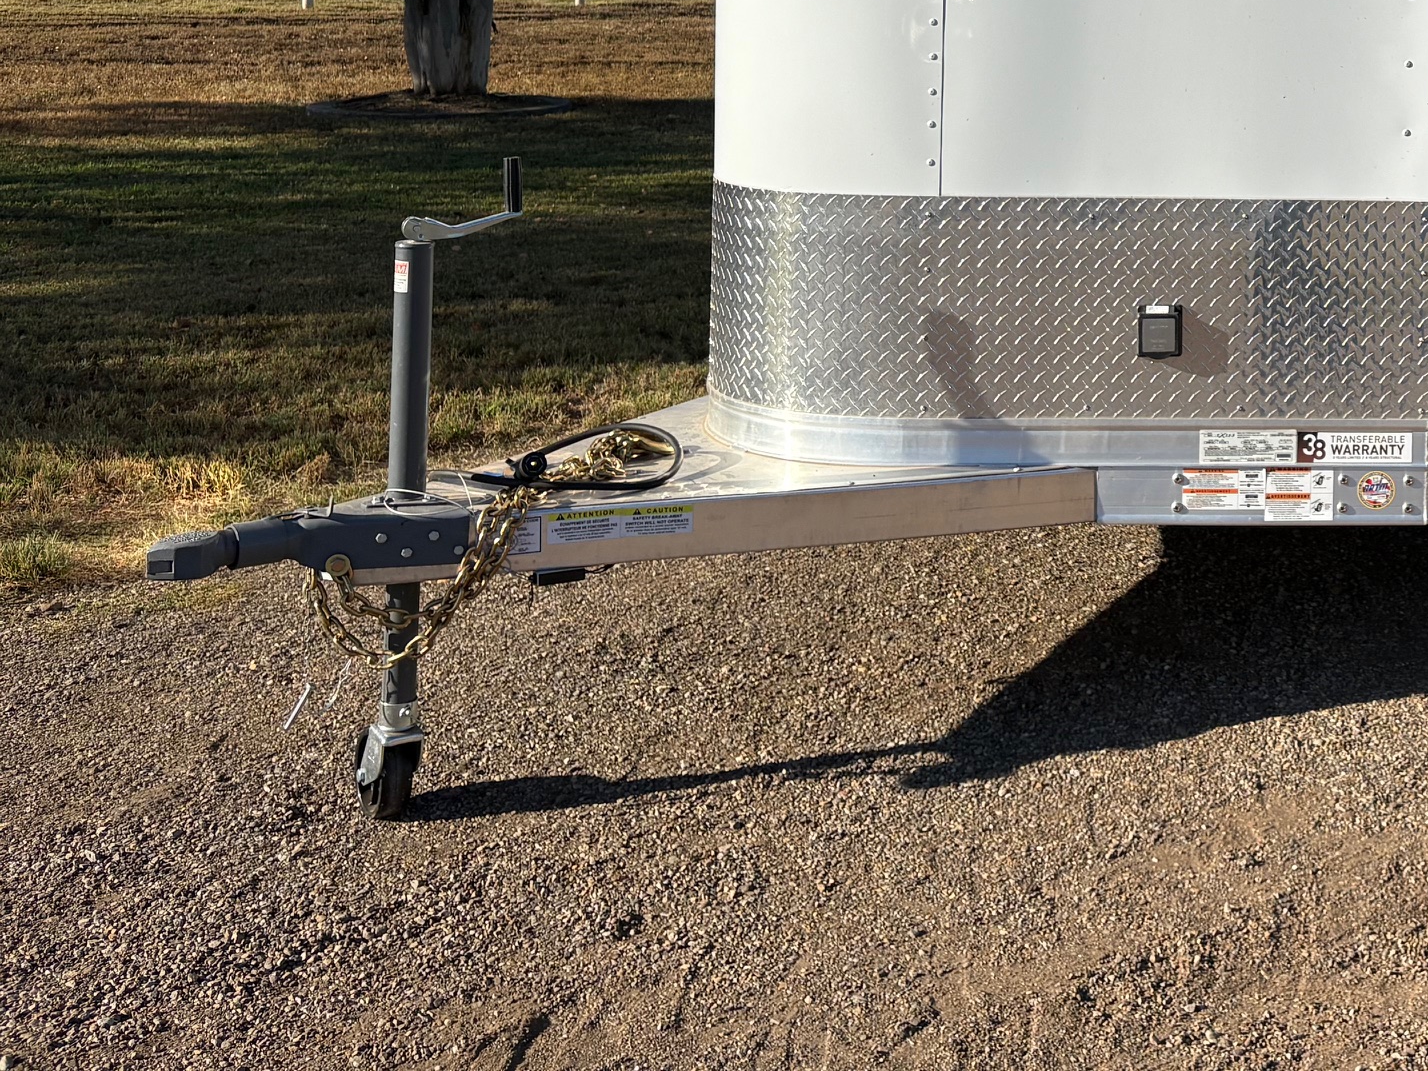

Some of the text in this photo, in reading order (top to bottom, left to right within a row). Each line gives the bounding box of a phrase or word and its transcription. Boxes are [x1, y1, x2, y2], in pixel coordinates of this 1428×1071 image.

[1330, 435, 1405, 443] TRANSFERABLE
[1330, 444, 1405, 455] WARRANTY
[567, 510, 615, 519] ATTENTION
